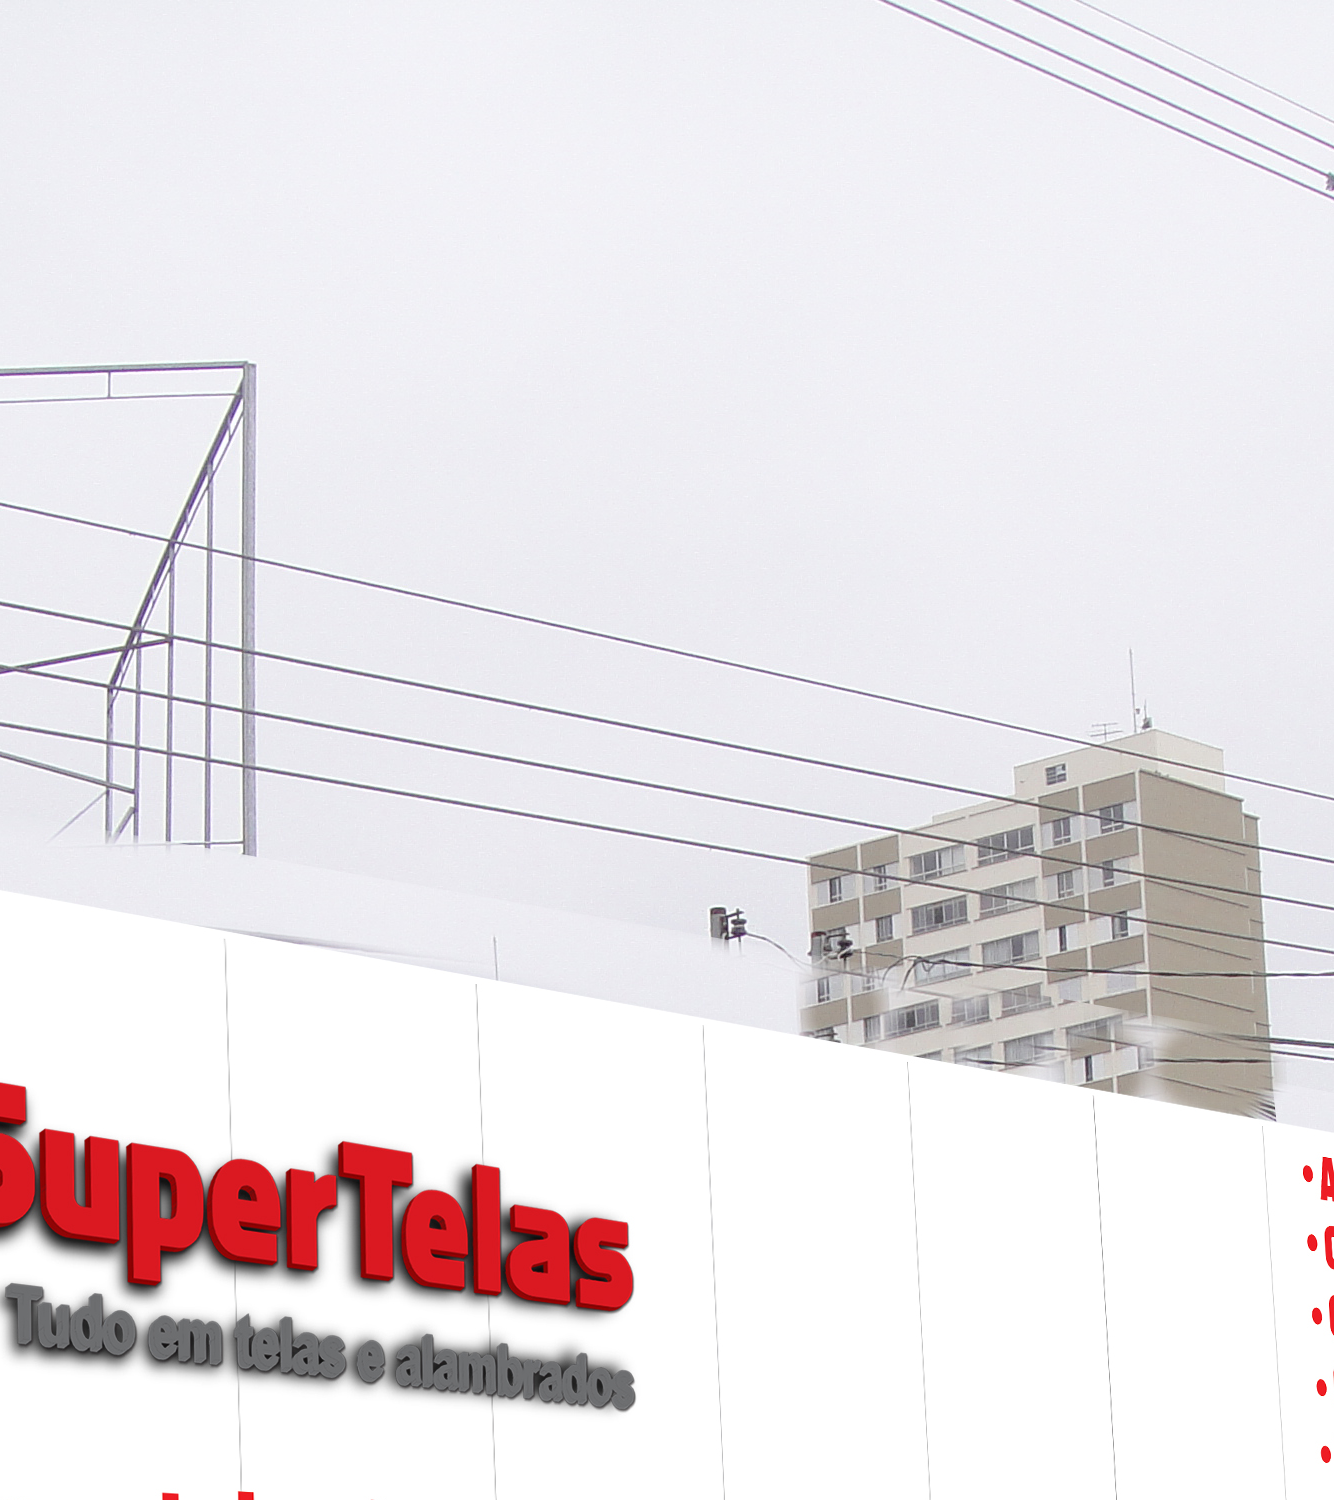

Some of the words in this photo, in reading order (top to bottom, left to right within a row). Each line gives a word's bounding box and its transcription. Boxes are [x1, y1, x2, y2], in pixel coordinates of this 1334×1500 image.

[5, 1283, 137, 1357] Tudo
[148, 1312, 224, 1367] em
[234, 1314, 346, 1382] telas
[356, 1342, 386, 1384] e
[394, 1336, 636, 1411] alambrados
